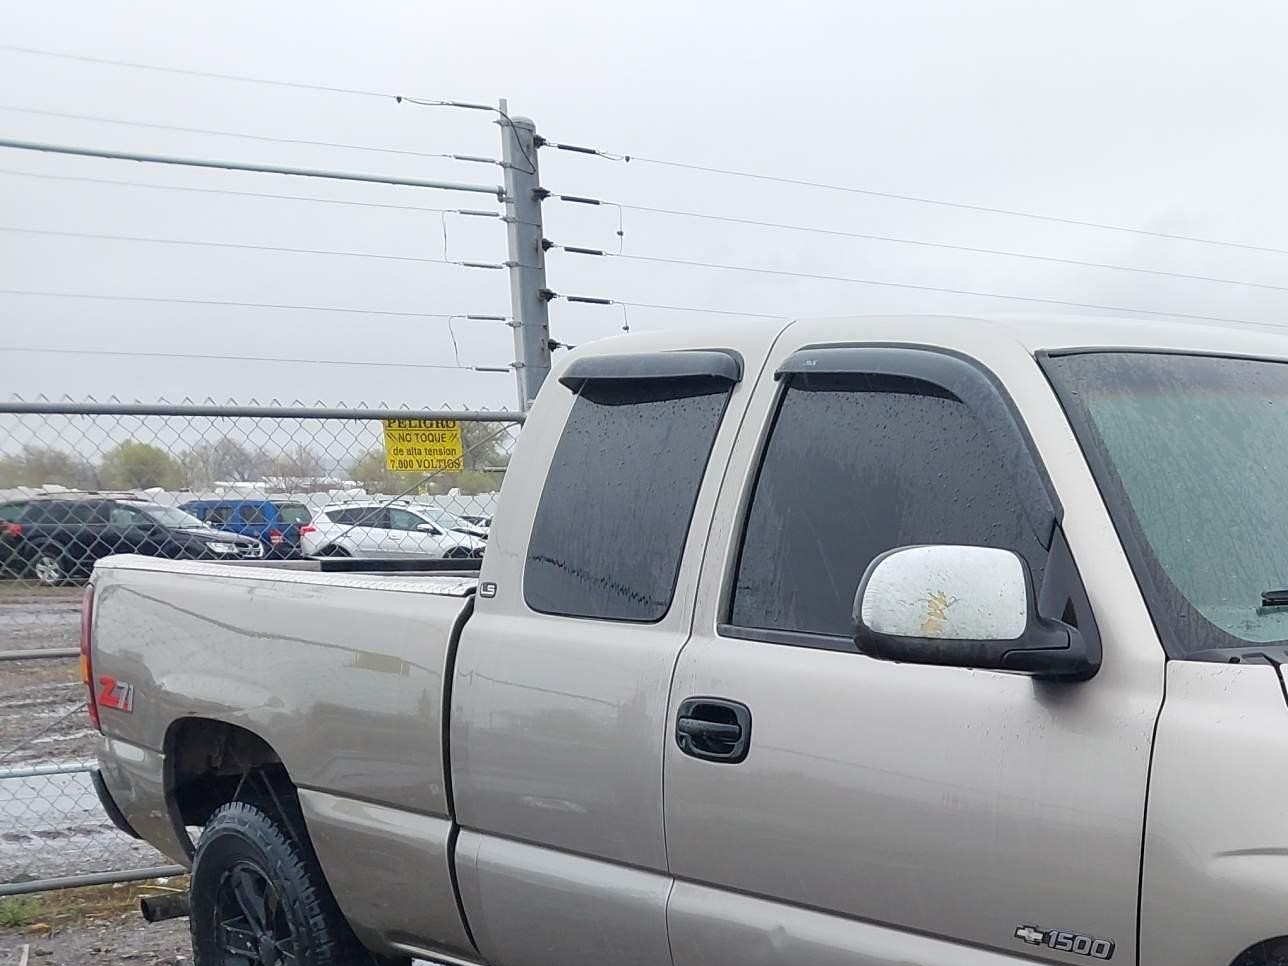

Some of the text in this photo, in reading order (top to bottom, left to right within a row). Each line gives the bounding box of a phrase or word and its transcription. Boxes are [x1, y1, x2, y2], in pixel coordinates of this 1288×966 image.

[398, 432, 447, 443] NO TOQUE
[392, 446, 457, 456] de alta tension
[1047, 930, 1114, 960] 1500
